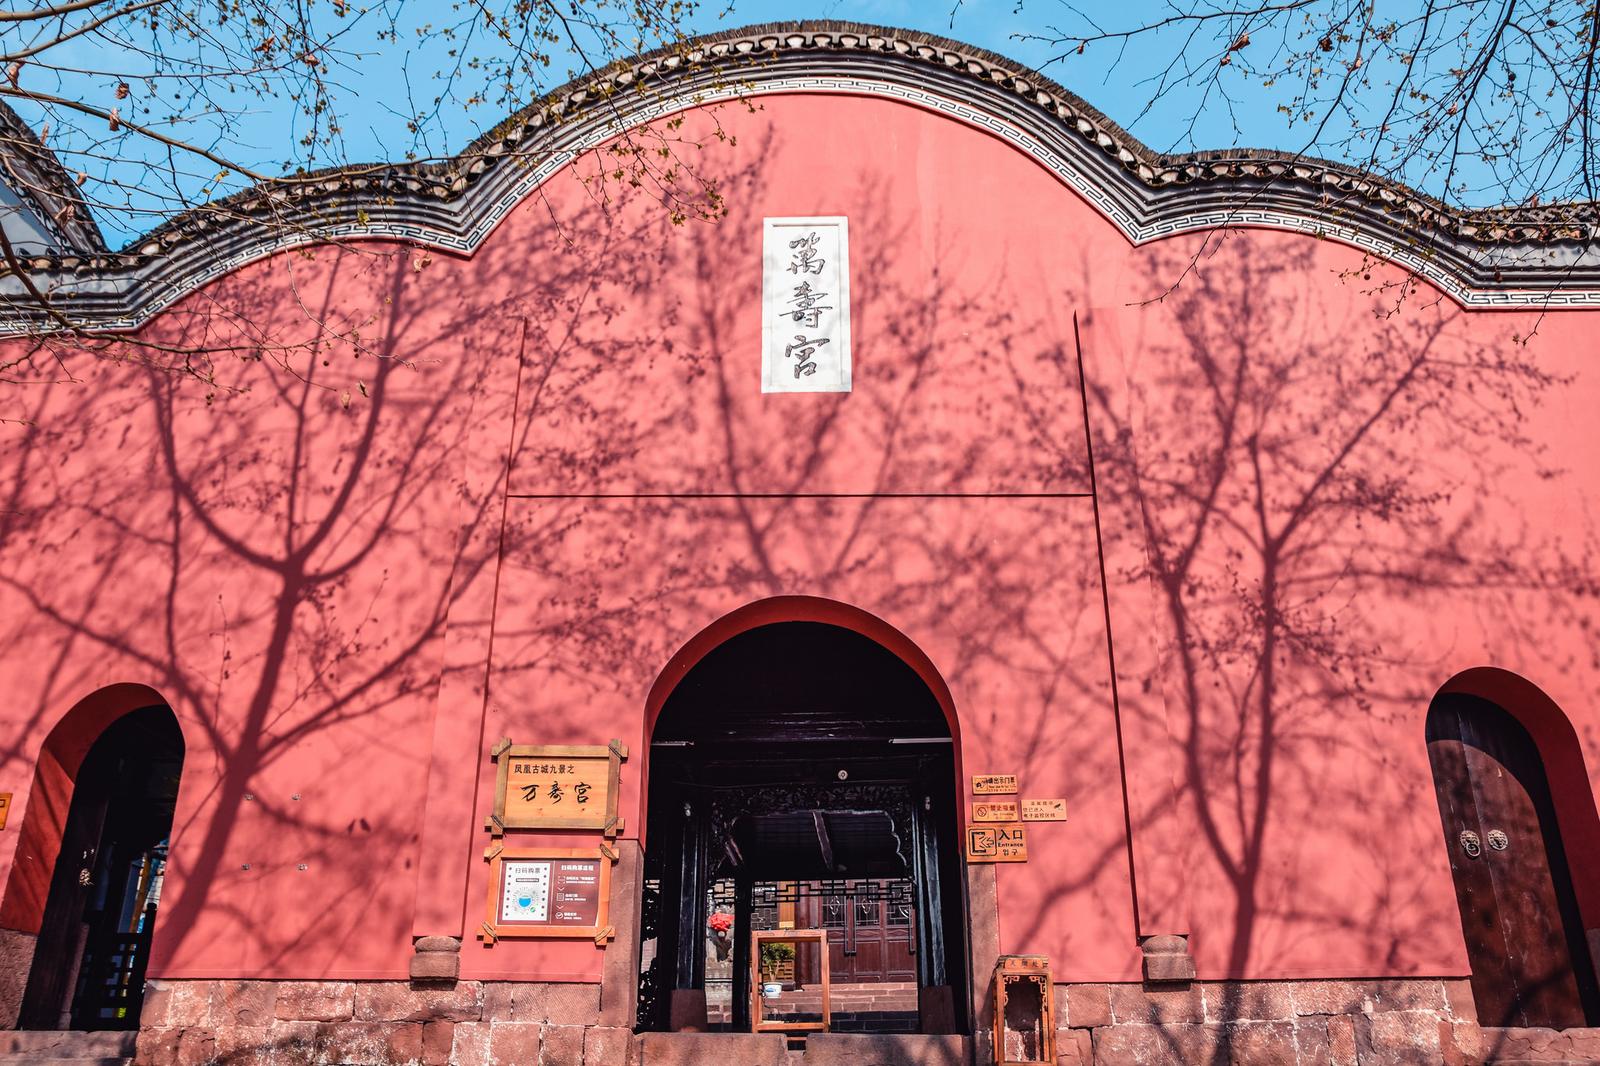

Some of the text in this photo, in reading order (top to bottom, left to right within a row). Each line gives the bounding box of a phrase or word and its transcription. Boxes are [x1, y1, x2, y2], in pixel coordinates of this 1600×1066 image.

[514, 764, 575, 775] 凤凰古城九景之
[519, 780, 592, 805] 万寿宫
[998, 829, 1023, 841] 入口
